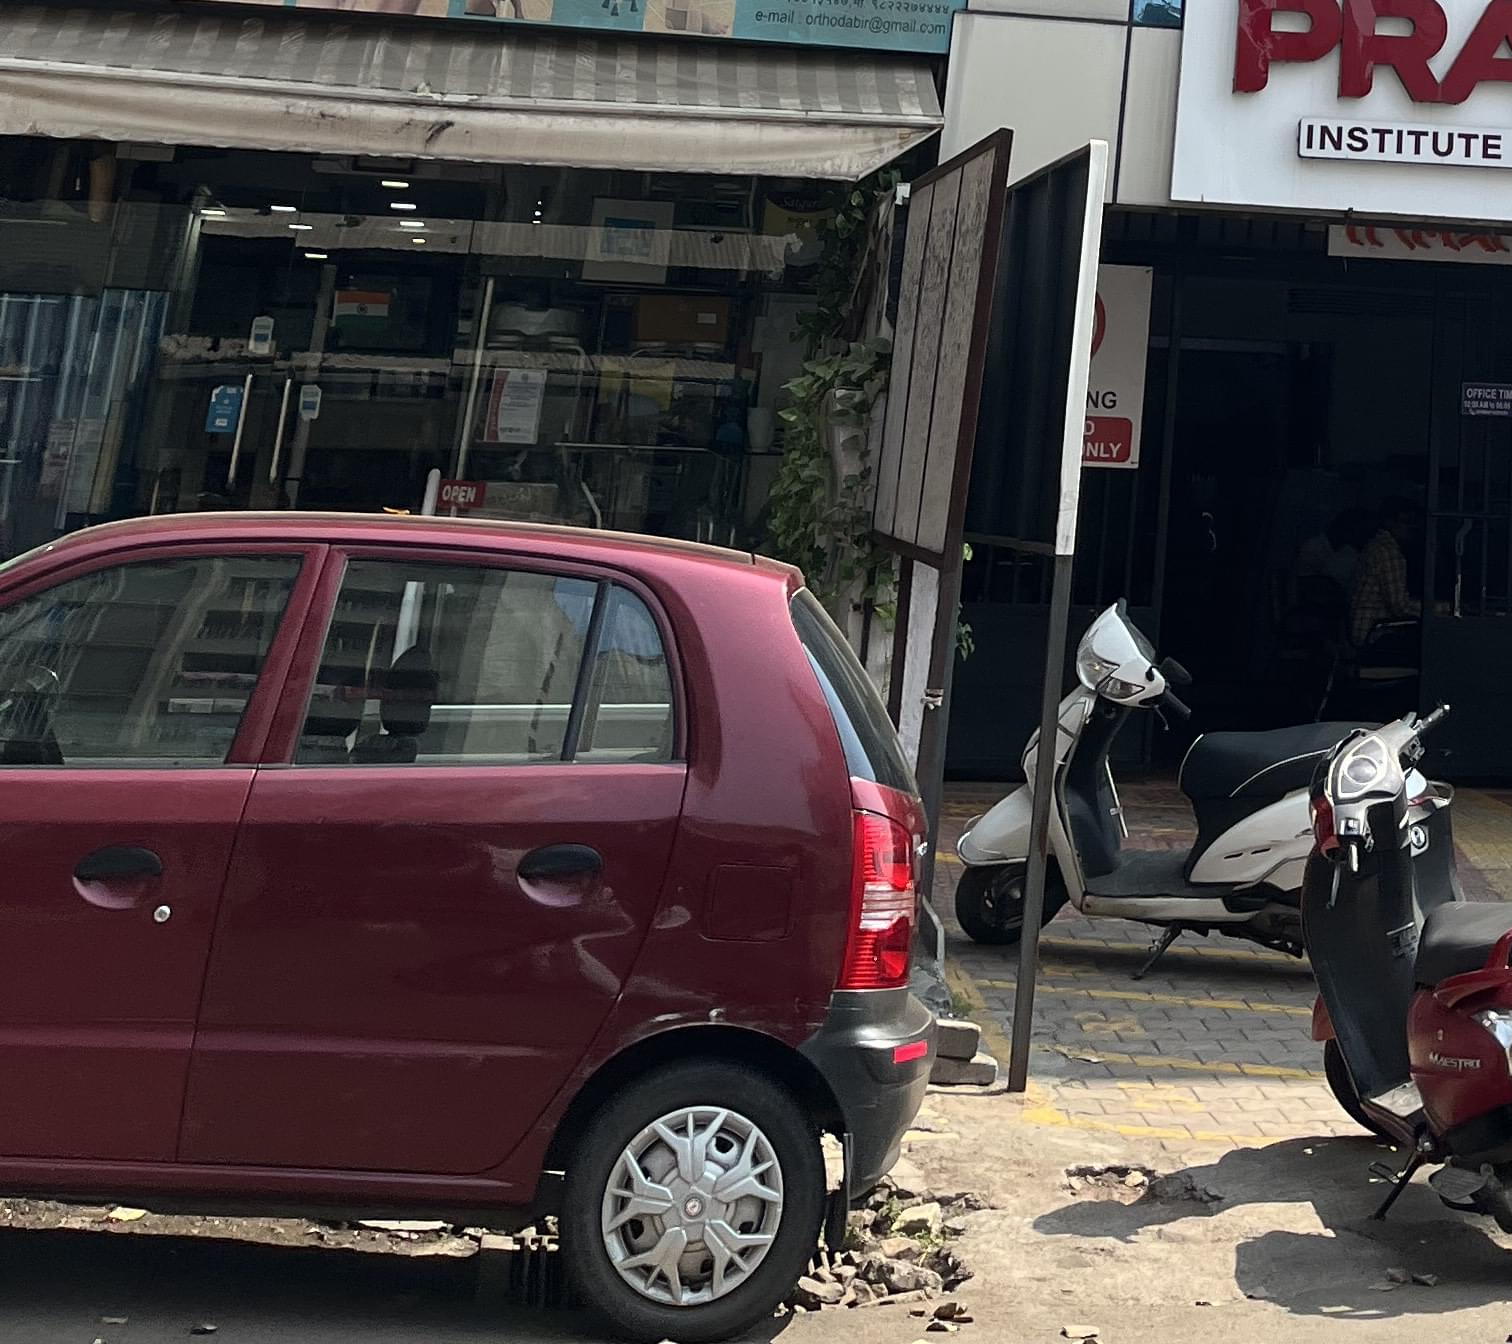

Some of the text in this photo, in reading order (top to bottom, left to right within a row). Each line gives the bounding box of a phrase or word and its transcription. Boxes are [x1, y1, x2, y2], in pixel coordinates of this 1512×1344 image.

[1306, 124, 1502, 160] INSTITUTE
[1466, 387, 1497, 400] OFFICE
[442, 485, 476, 503] OPEN
